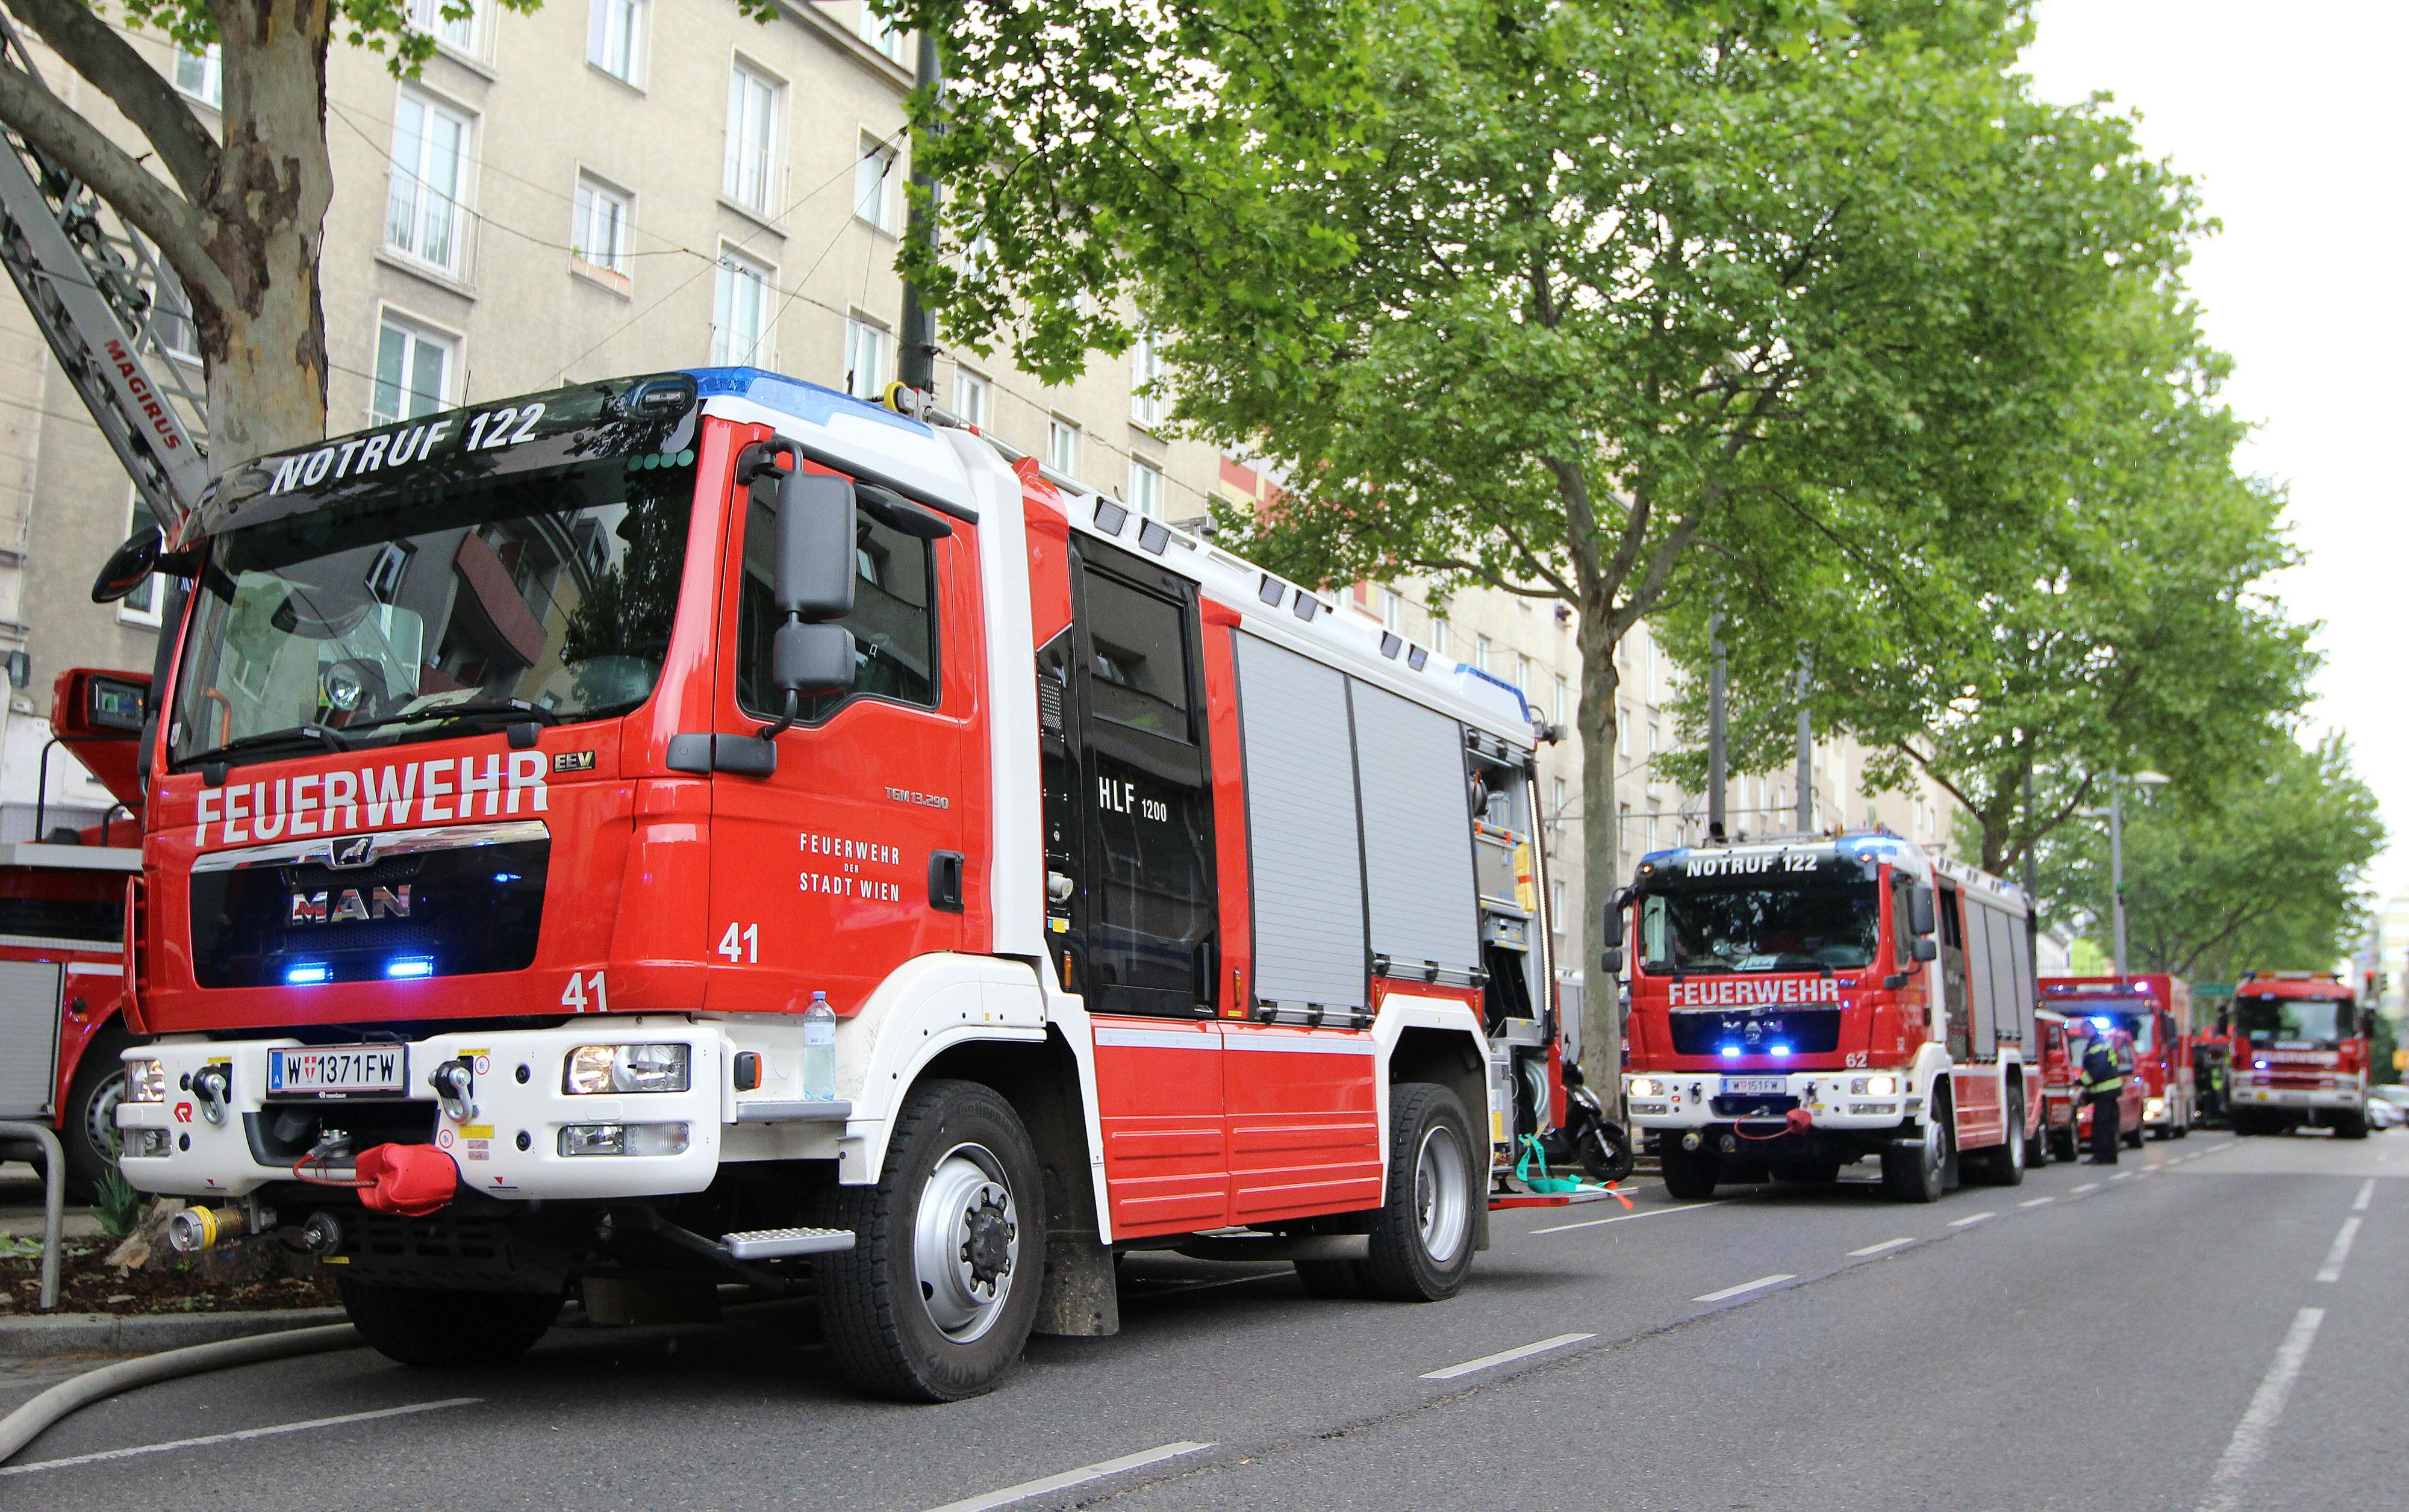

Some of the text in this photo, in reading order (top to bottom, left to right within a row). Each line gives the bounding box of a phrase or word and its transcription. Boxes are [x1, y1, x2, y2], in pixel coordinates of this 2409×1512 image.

[104, 340, 181, 450] MAGIRUS
[269, 403, 546, 496] NOTRUF 122
[555, 751, 593, 770] EEV
[195, 750, 549, 847] FEUERWEHR
[885, 786, 949, 809] TGM 13.290
[1099, 776, 1167, 823] HLF 1200
[799, 832, 900, 865] FEUERWEHR
[844, 863, 859, 874] DER
[1686, 854, 1818, 877] NOTRUF 122
[799, 872, 900, 903] STADT WIEN
[291, 885, 411, 925] MAN
[718, 922, 758, 963] 41
[561, 971, 608, 1012] 41
[1669, 978, 1839, 1006] FEUERWEHR
[288, 1054, 396, 1084] W 1371FW
[1845, 1053, 1868, 1068] 62
